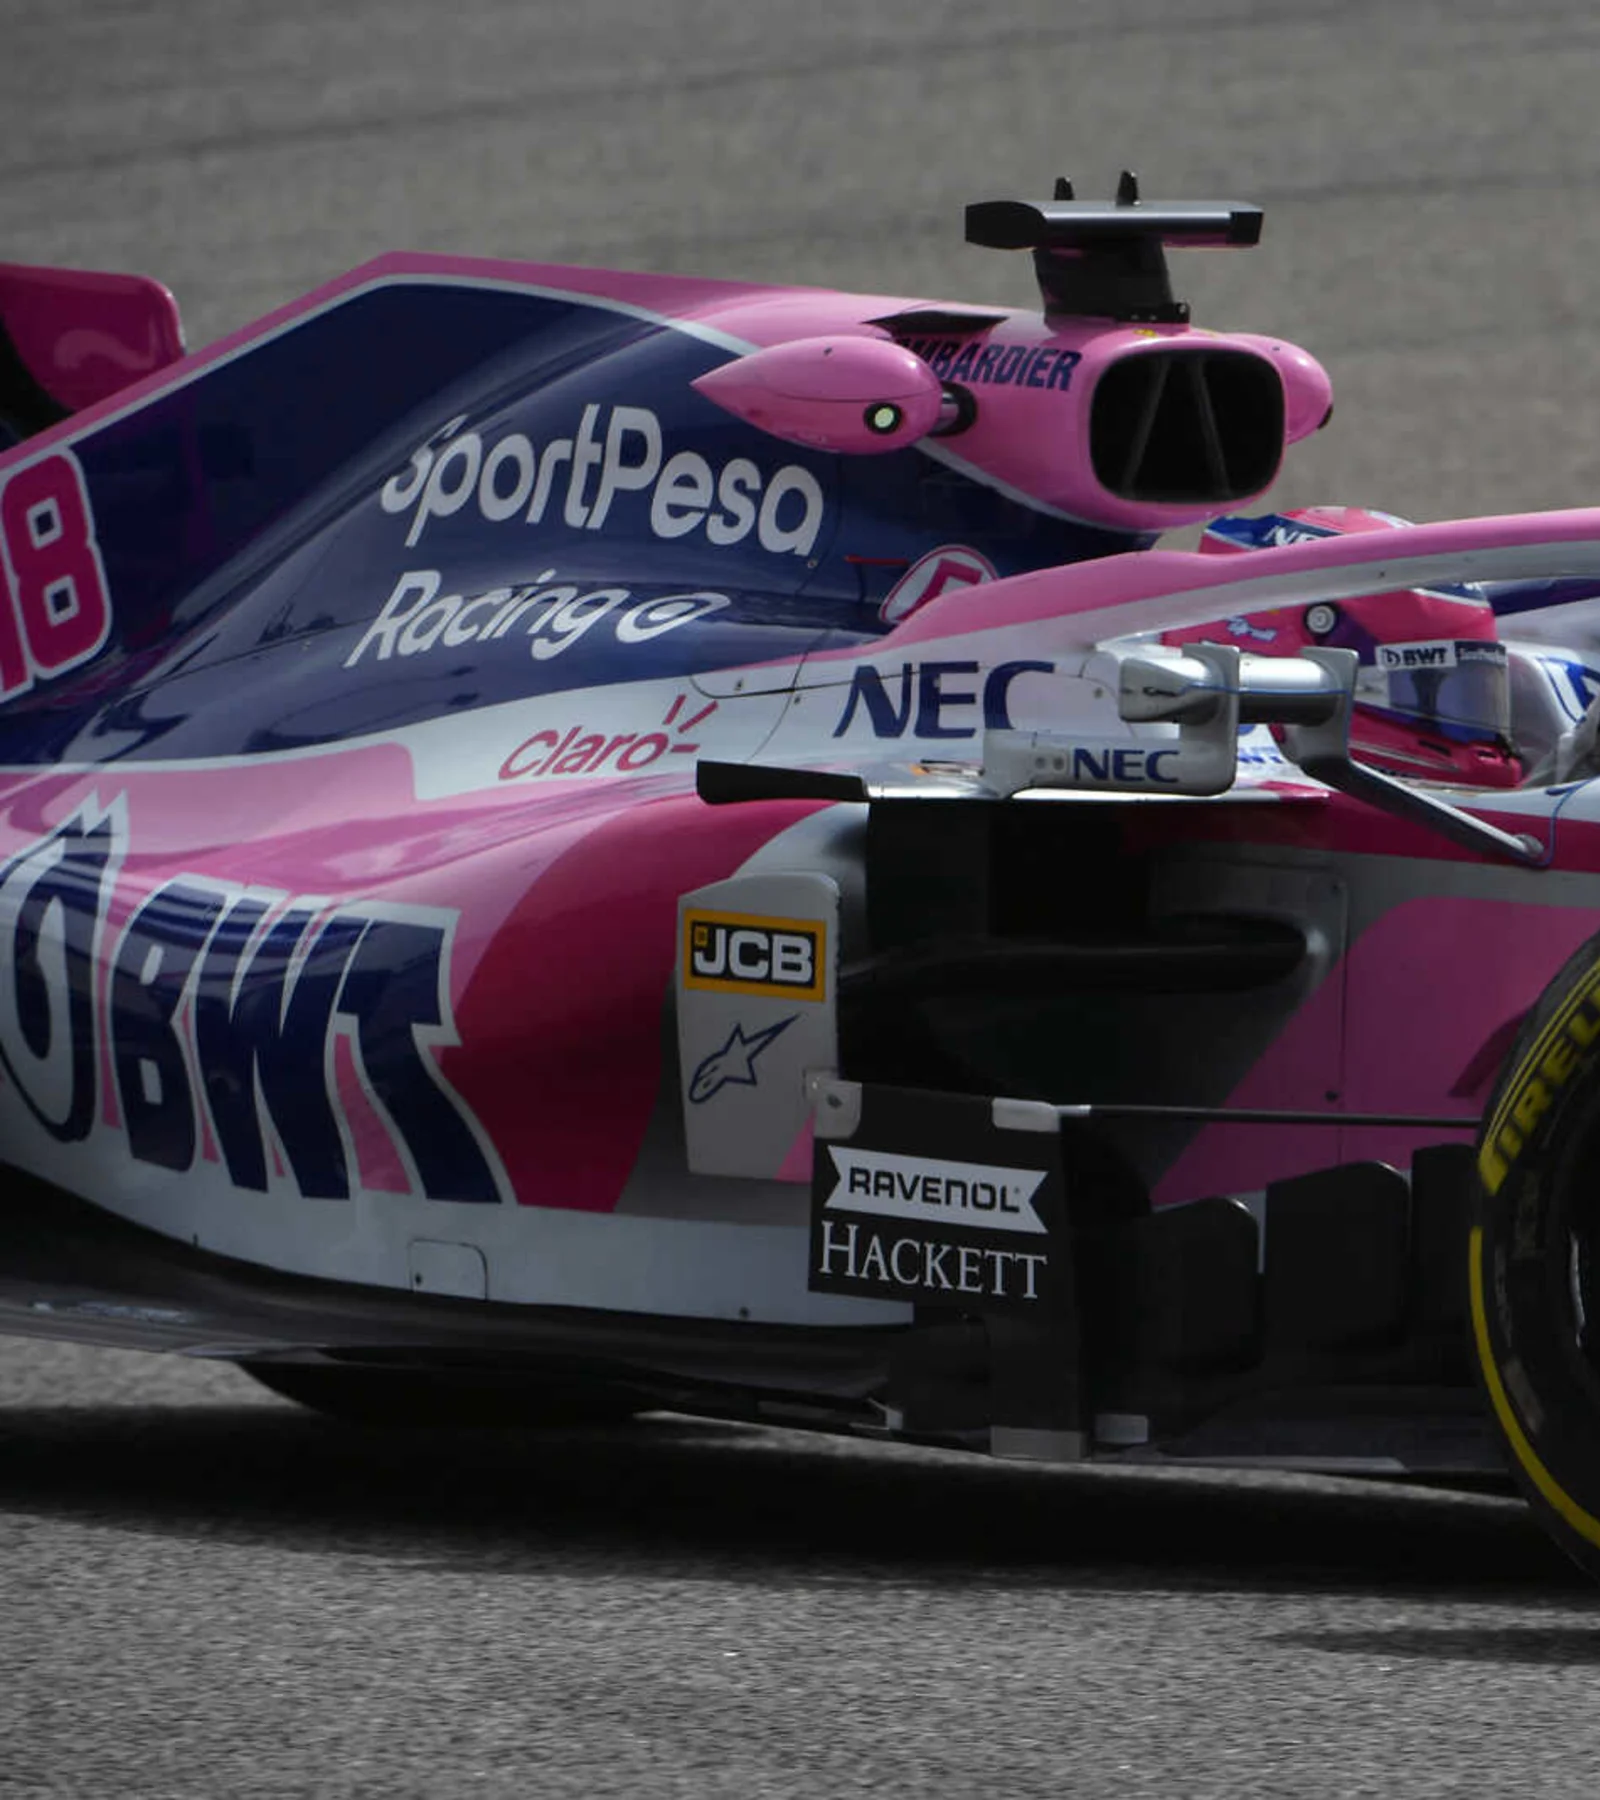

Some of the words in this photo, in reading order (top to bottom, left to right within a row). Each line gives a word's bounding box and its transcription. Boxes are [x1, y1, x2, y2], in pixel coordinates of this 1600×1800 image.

[896, 338, 1082, 391] MBARDIER
[380, 404, 823, 555] SportPesa
[343, 569, 608, 668] Racing
[1402, 647, 1447, 666] BWT
[833, 661, 1055, 738] NEC
[498, 725, 669, 780] Claro
[1073, 748, 1180, 783] NEC
[693, 928, 814, 983] JCB
[108, 878, 505, 1204] BWT
[818, 1220, 1049, 1299] HACKETT
